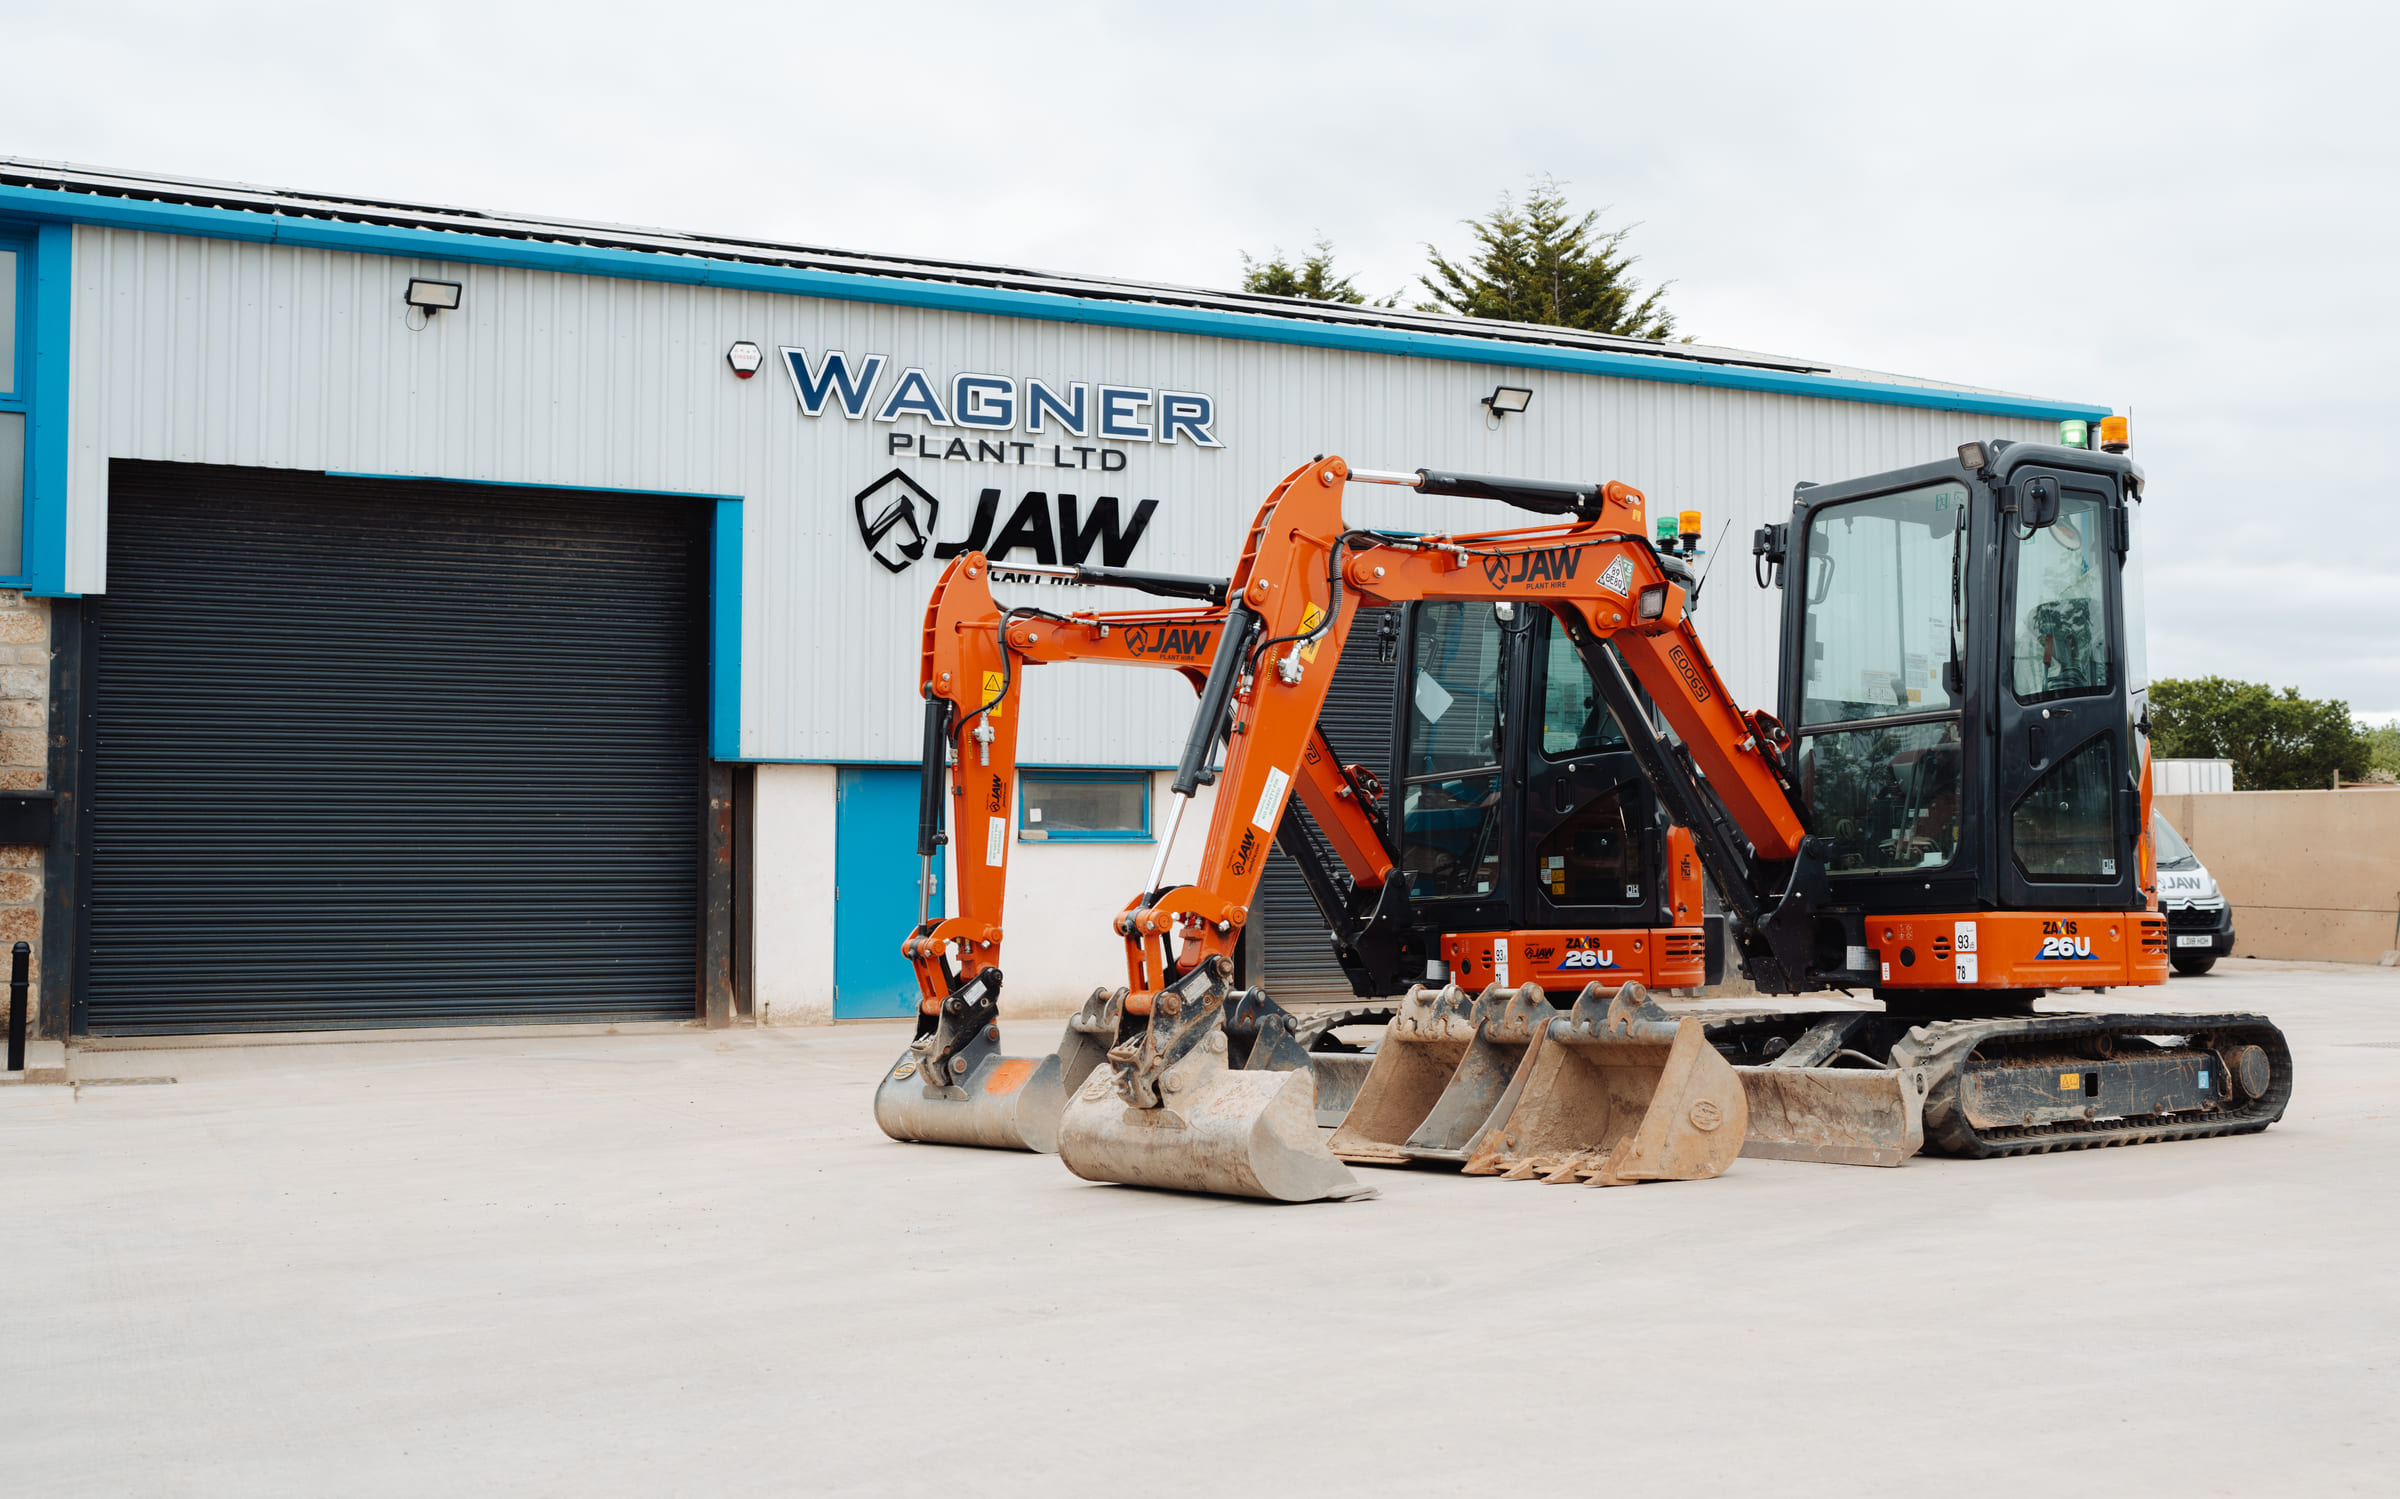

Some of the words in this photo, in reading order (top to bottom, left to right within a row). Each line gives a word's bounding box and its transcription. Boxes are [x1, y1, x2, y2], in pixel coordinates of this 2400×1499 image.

[779, 346, 1226, 448] WAGNER
[888, 432, 1034, 466] PLANT
[1055, 445, 1127, 471] LTD
[933, 488, 1160, 567] JAW
[1511, 548, 1583, 583] JAW
[1526, 582, 1548, 590] PLANT
[1550, 581, 1566, 589] HIRE
[1147, 628, 1211, 655] JAW
[1672, 649, 1707, 698] E0065
[992, 773, 1002, 804] JAW
[1238, 827, 1255, 866] JAW
[2168, 877, 2200, 890] JAW
[2043, 918, 2077, 935] ZAXIS
[1565, 935, 1600, 949] ZAXIS
[1957, 934, 1969, 949] 93
[2043, 936, 2090, 958] 26U
[1496, 949, 1503, 961] 93
[1533, 948, 1555, 958] JAW
[1565, 950, 1613, 968] 26U
[1957, 965, 1966, 980] 78
